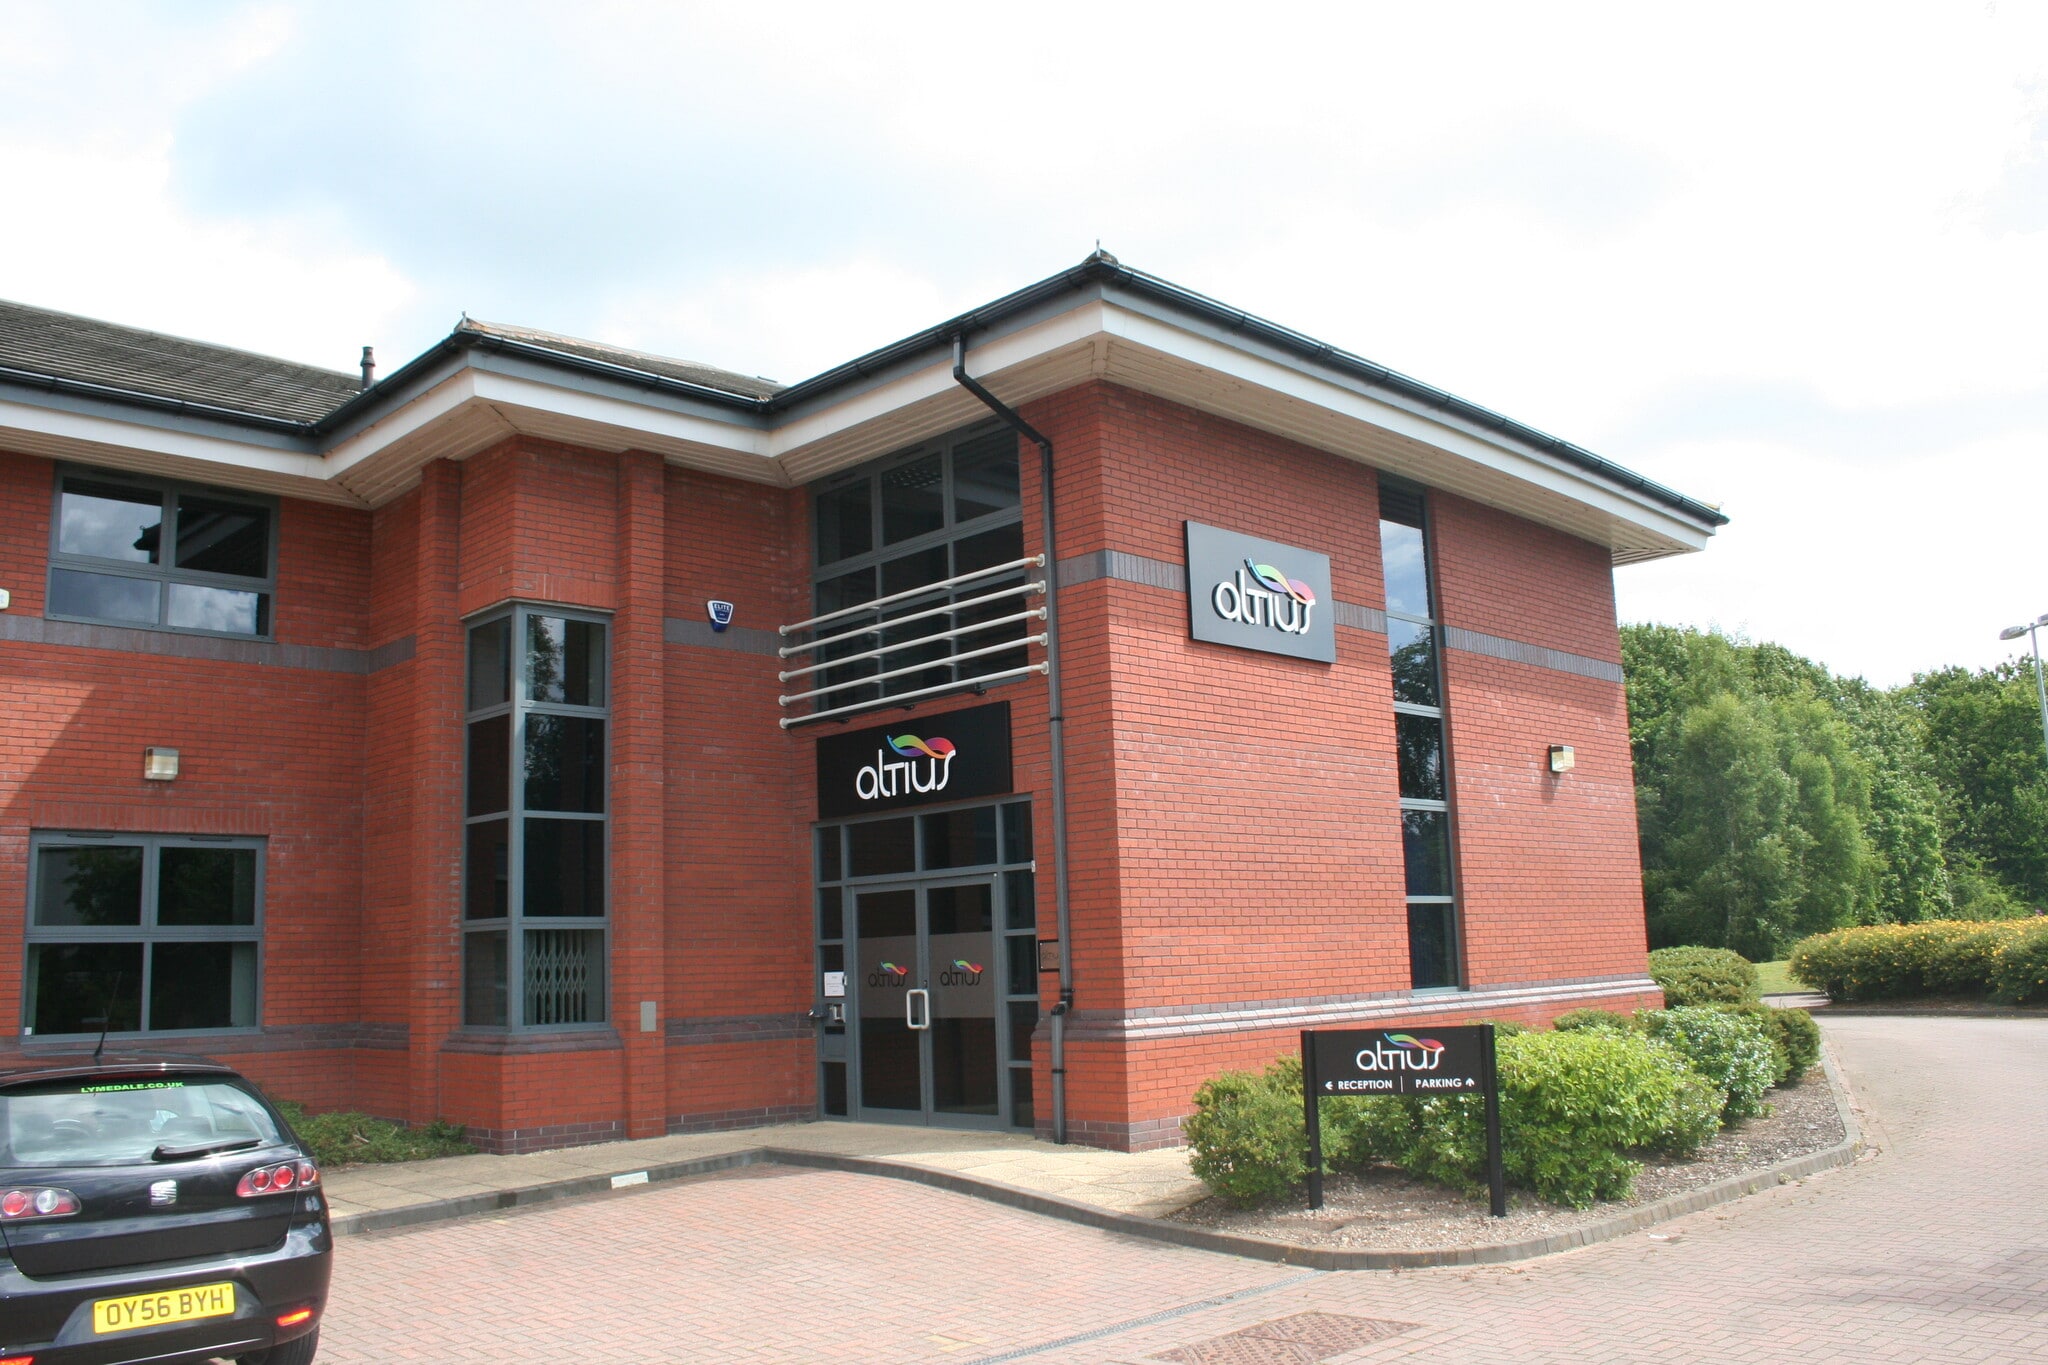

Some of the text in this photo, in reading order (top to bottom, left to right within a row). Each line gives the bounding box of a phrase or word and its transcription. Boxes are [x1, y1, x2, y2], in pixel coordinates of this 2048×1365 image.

[81, 1082, 184, 1093] LYMEDALE.CO.UK
[1338, 1078, 1462, 1090] RECEPTION PARKING
[106, 1288, 224, 1326] OY56 BYH
